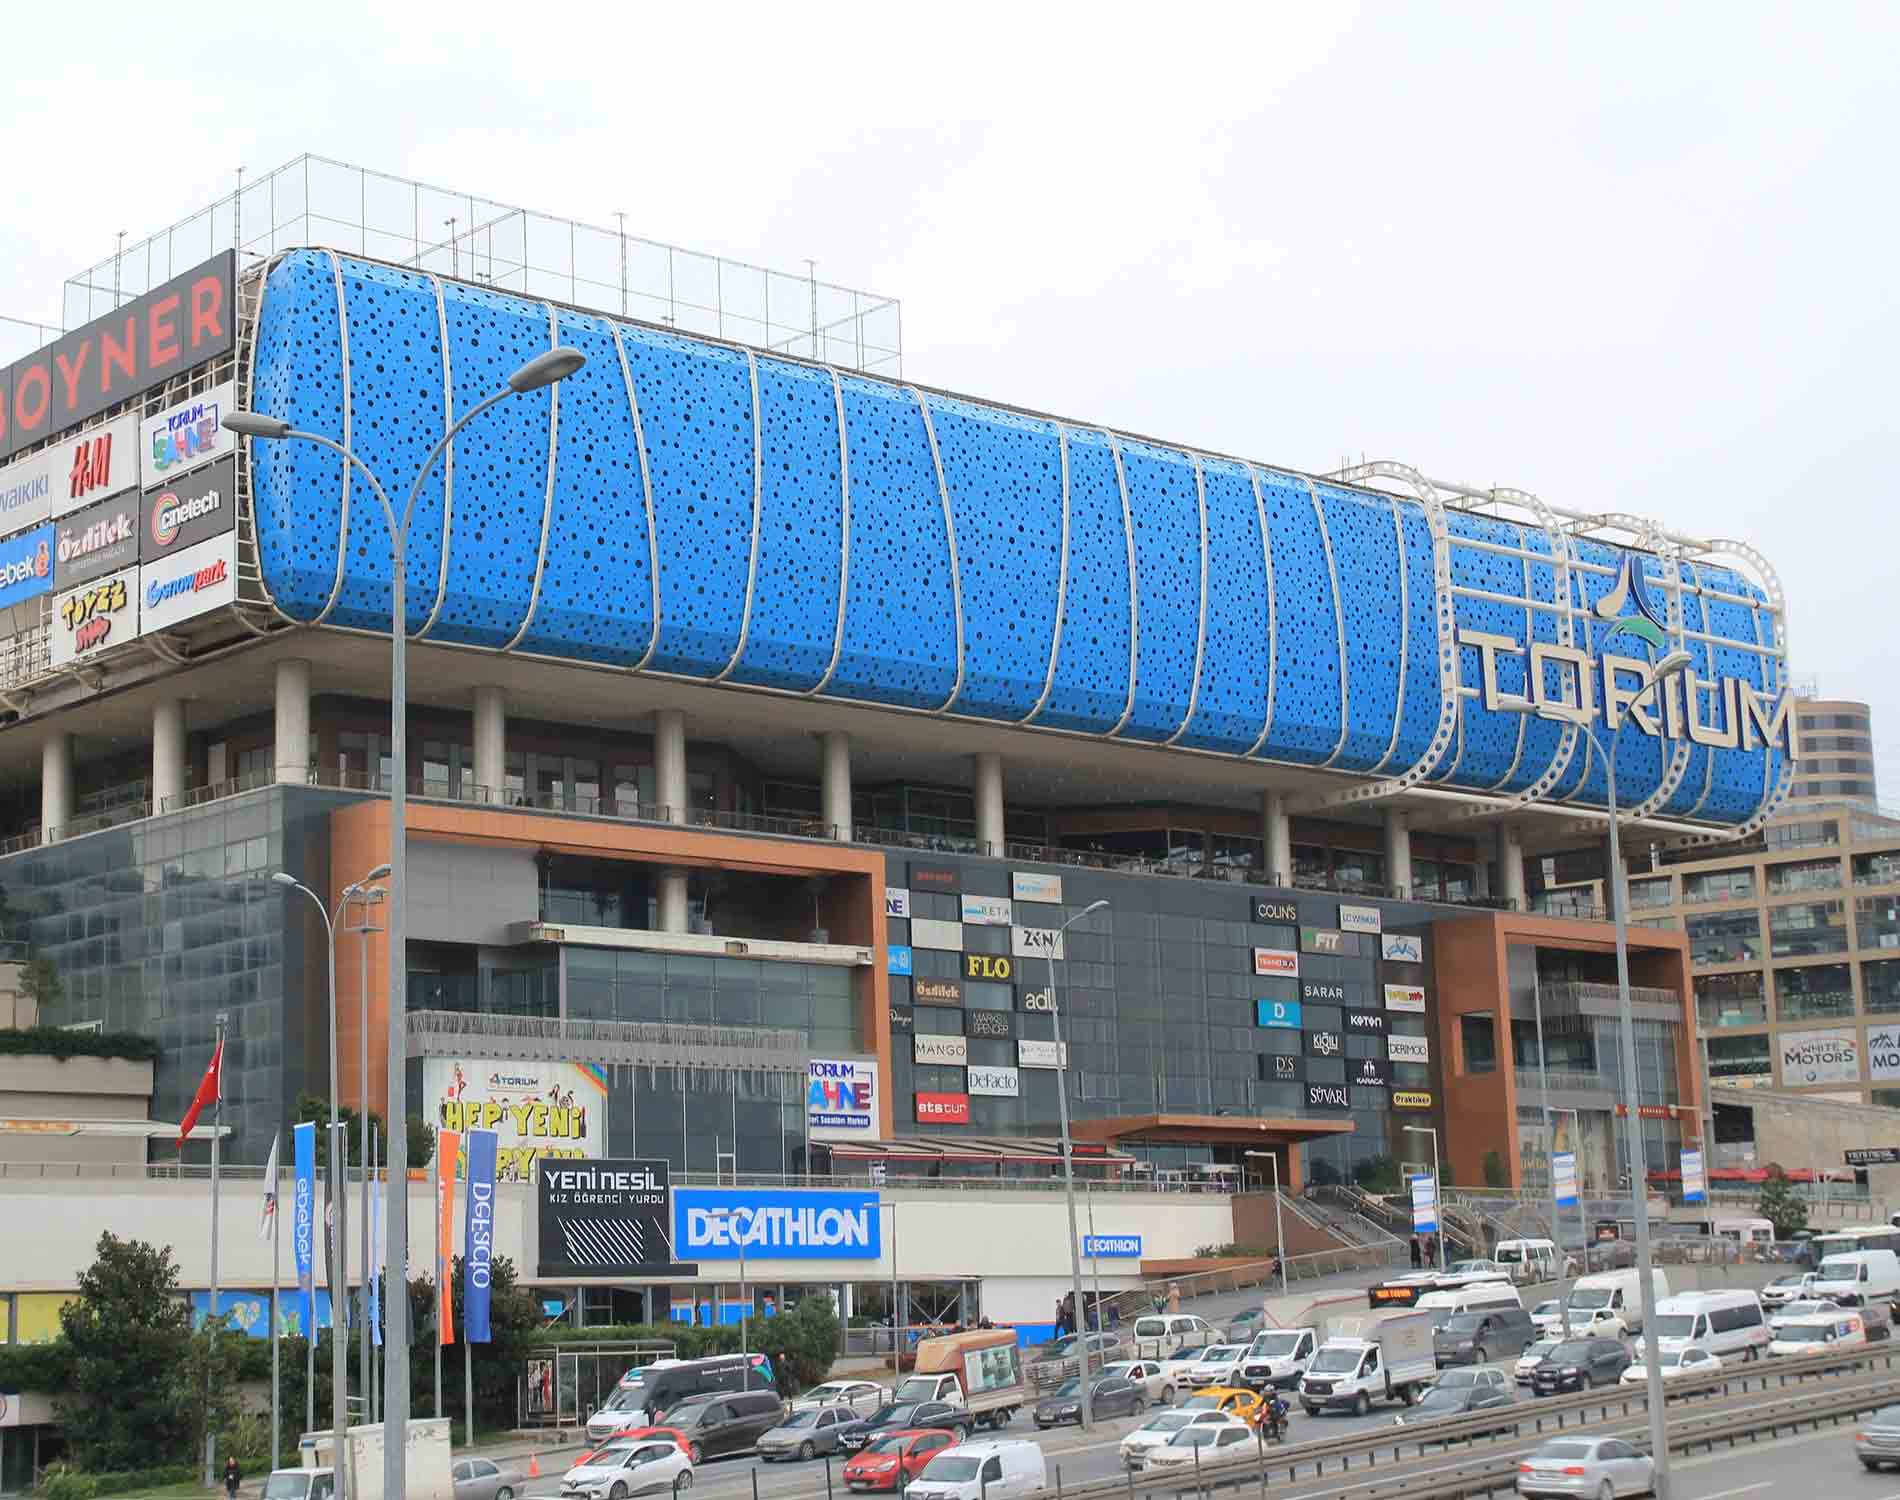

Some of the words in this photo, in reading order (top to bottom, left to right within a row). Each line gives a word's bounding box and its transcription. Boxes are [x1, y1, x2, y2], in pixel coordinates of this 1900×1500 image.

[0, 275, 223, 445] OYNER
[167, 404, 203, 432] TORIUM
[68, 432, 112, 498] H&M
[58, 512, 134, 562] Özdilek
[1453, 624, 1799, 762] TORIUM
[1258, 904, 1297, 921] COLIN'S
[967, 954, 1012, 979] FLO
[1304, 985, 1344, 999] SARAR
[915, 1044, 967, 1057] MANGO
[1784, 1049, 1854, 1065] MOTORS
[809, 1062, 855, 1078] TORIUM
[969, 1072, 1017, 1089] DeFacto
[502, 1077, 538, 1086] TORIUM
[446, 1101, 501, 1133] HEP
[549, 1193, 567, 1204] KIZ
[628, 1194, 664, 1204] YURDU
[687, 1206, 869, 1247] DECATHLON
